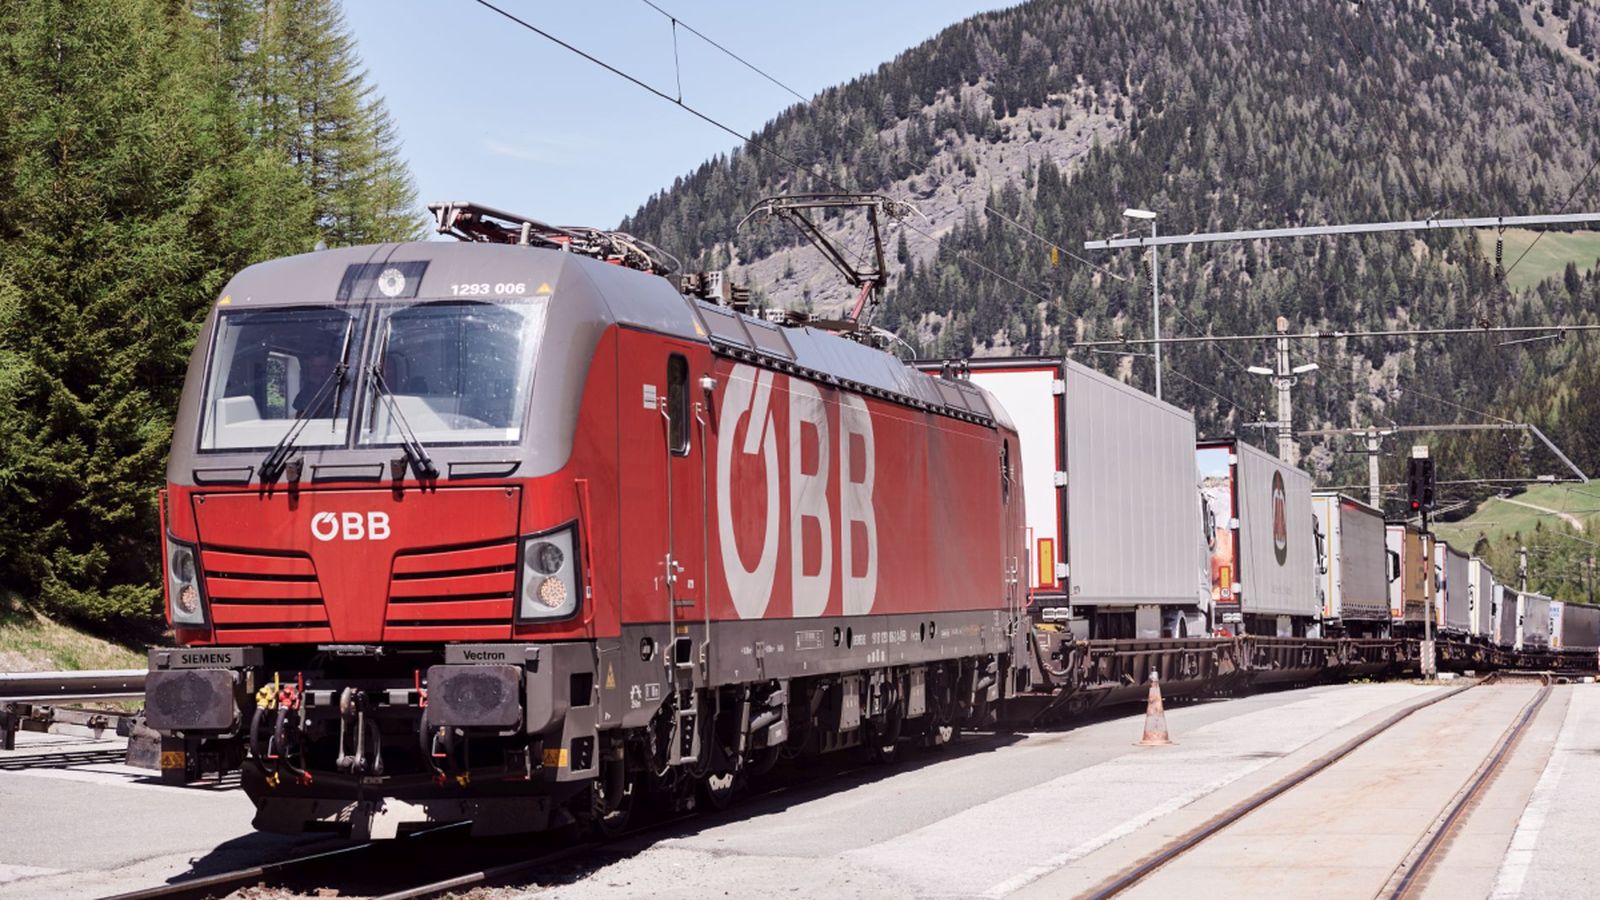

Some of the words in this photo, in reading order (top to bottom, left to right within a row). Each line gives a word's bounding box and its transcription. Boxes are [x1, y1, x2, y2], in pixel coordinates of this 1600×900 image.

[450, 283, 490, 296] 1293
[494, 282, 526, 295] 006
[716, 362, 879, 621] ÖBB
[310, 511, 392, 542] ÖBB
[181, 653, 232, 665] SIEMENS
[463, 649, 506, 661] Vectron
